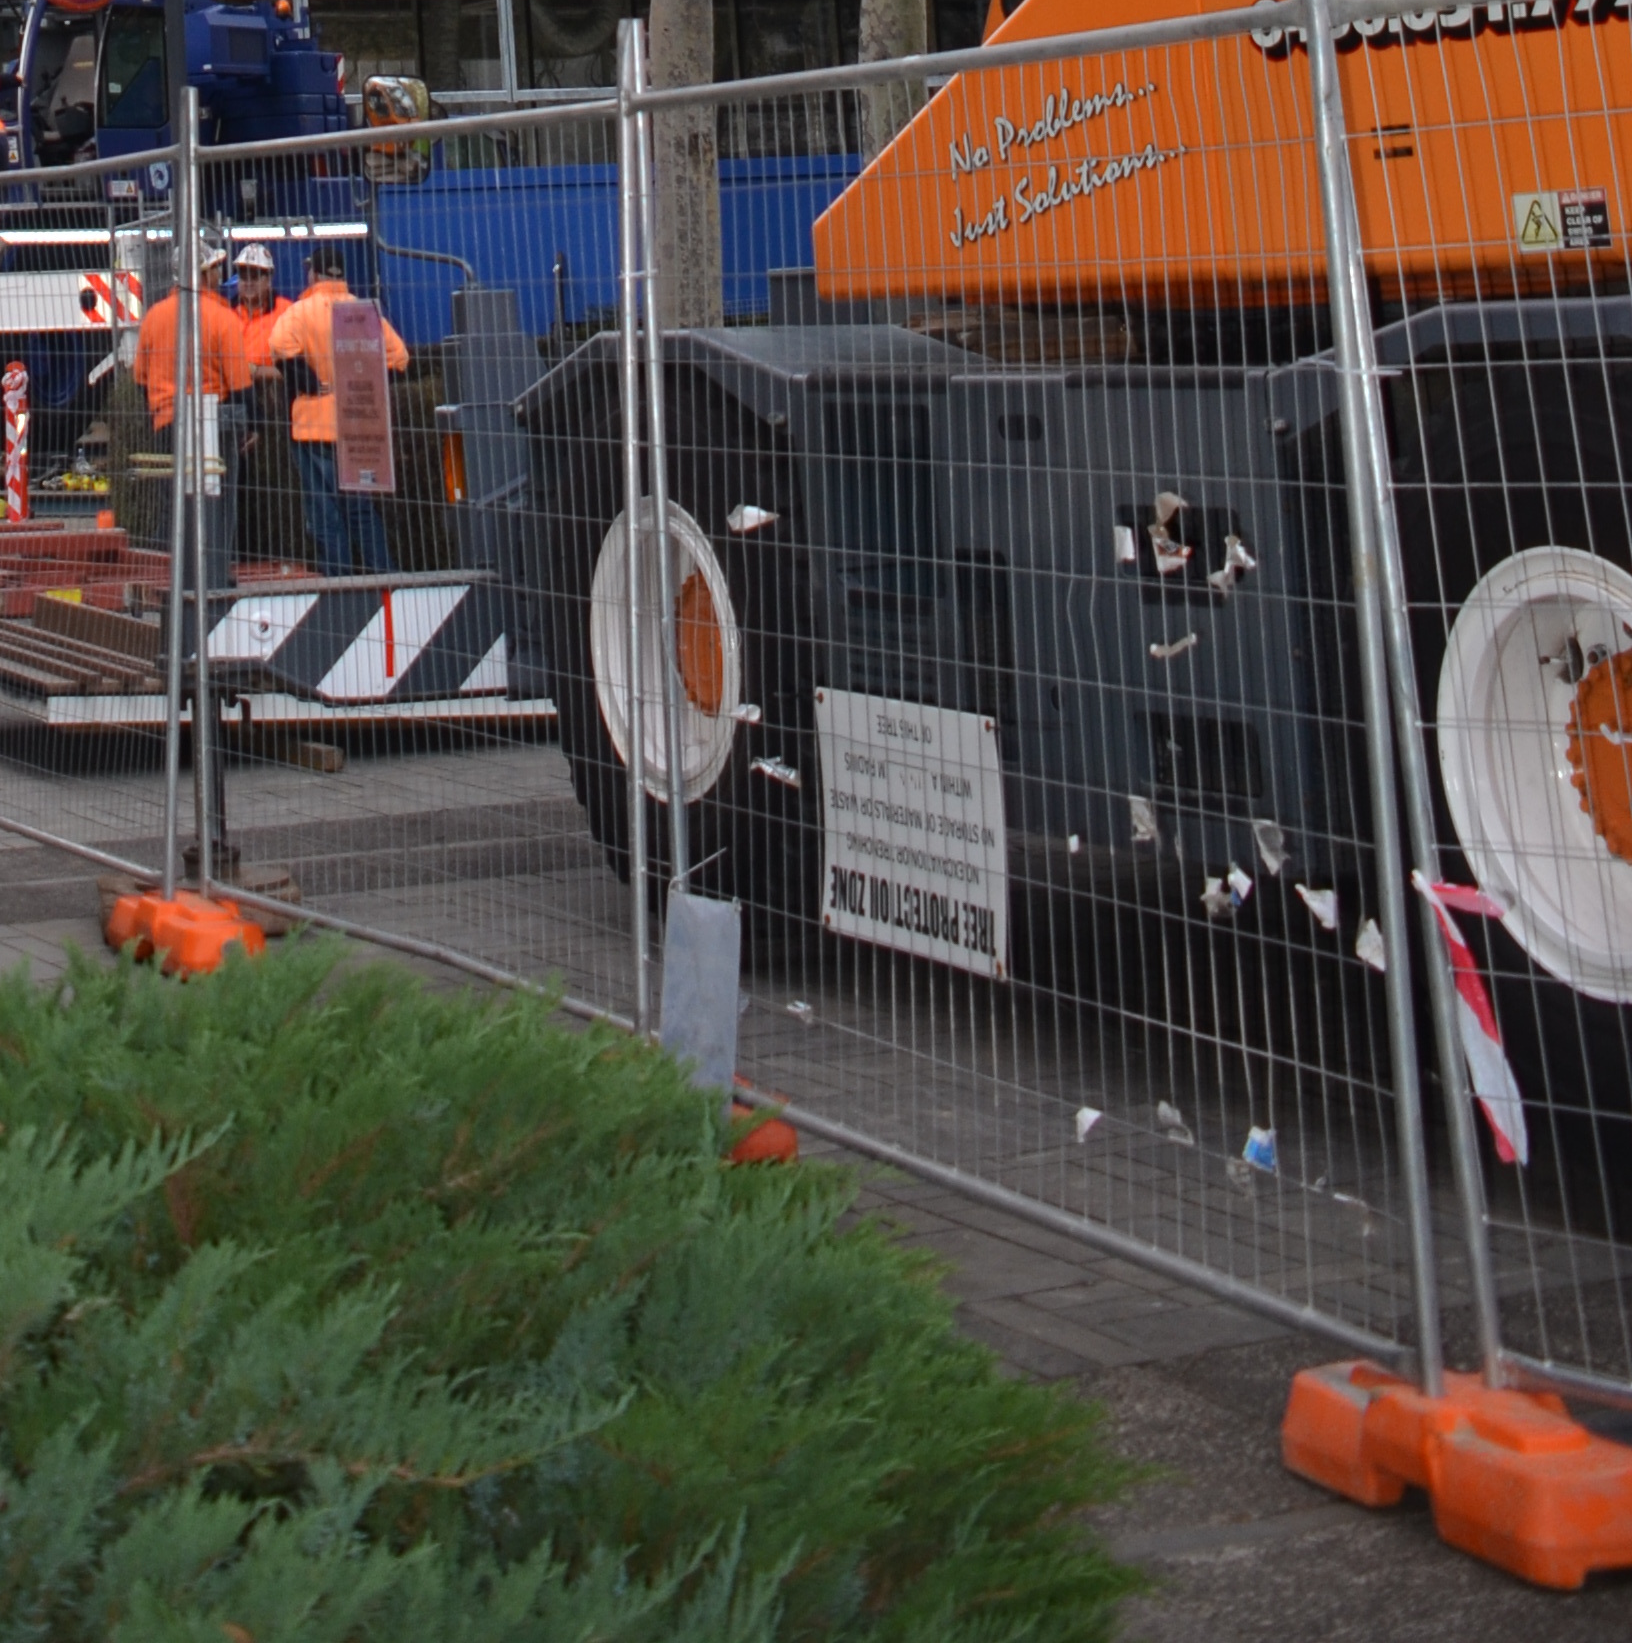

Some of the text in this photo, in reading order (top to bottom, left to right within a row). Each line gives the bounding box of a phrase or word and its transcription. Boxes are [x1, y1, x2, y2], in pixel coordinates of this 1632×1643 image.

[949, 132, 989, 181] No
[949, 194, 1009, 248] Just
[875, 714, 899, 738] TREE
[830, 787, 859, 815] WASTE
[931, 771, 939, 791] A
[830, 865, 866, 917] ZONE
[962, 901, 997, 957] TREE
